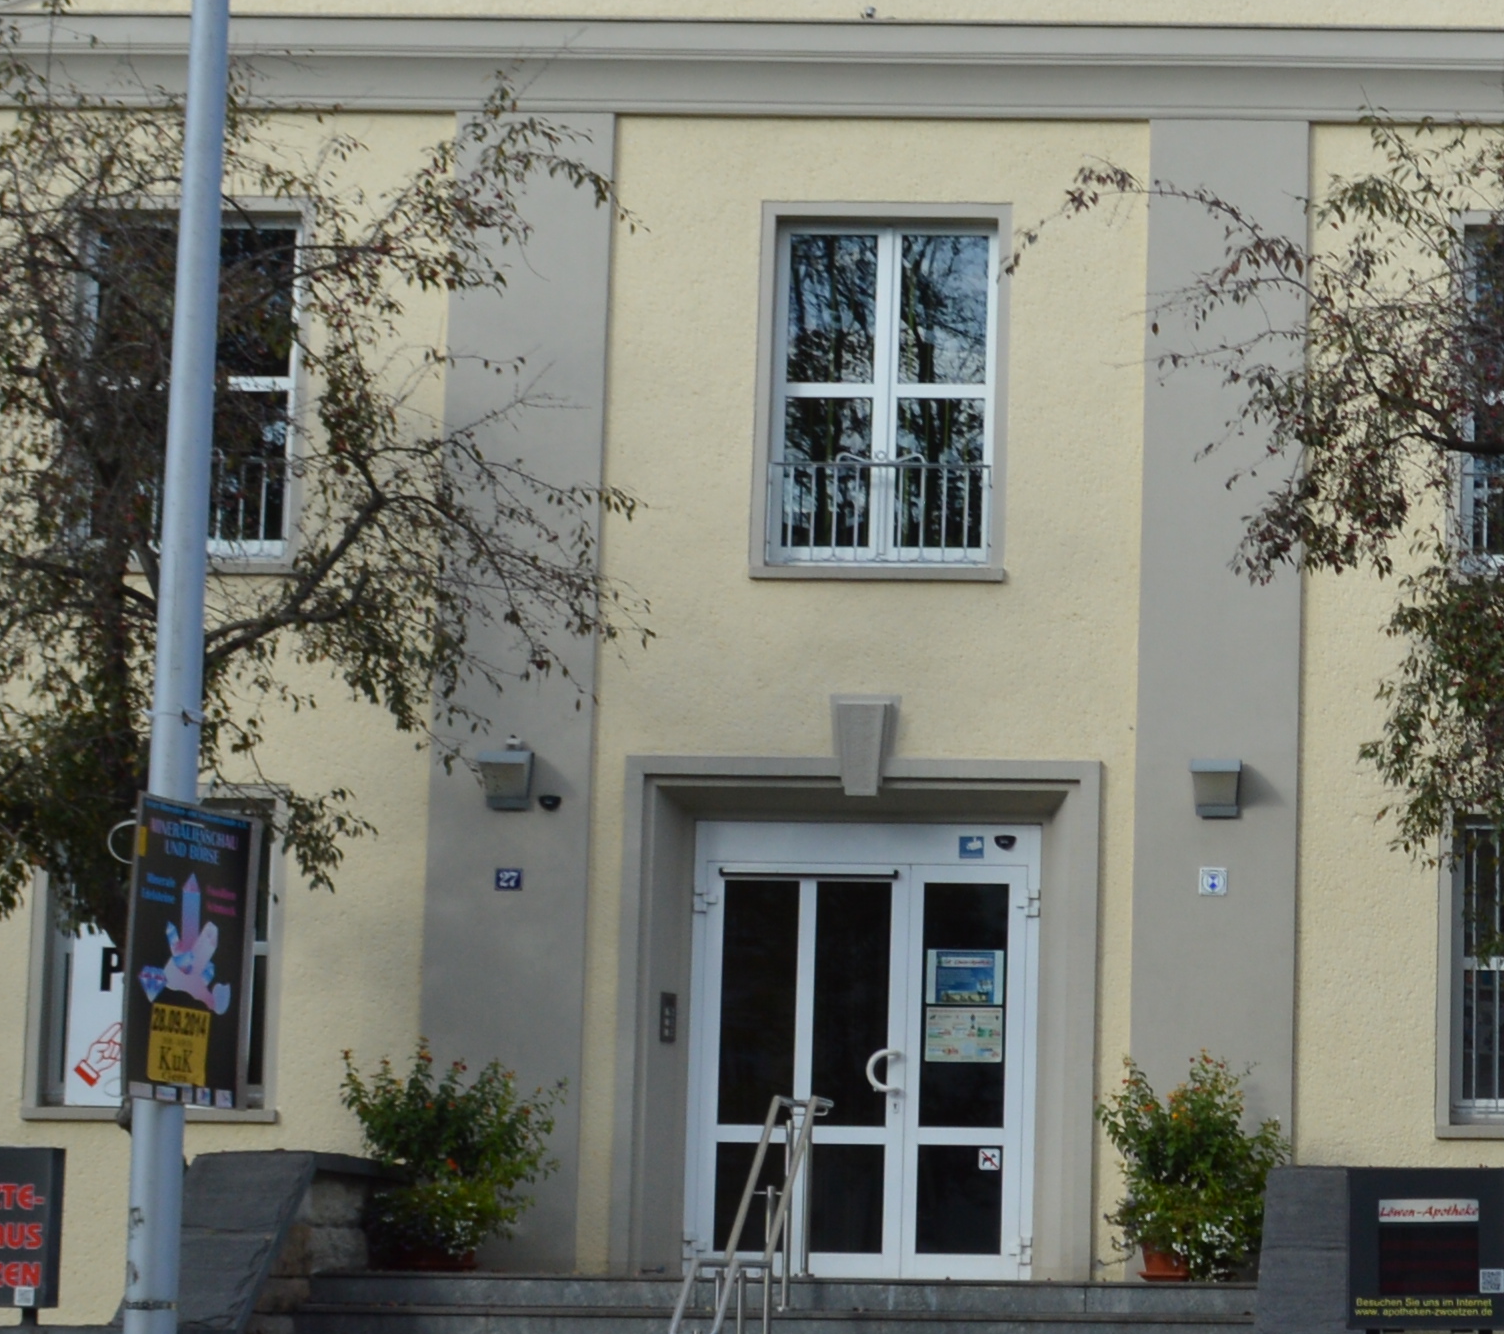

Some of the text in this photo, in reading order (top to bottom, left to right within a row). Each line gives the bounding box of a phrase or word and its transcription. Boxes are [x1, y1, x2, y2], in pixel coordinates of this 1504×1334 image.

[499, 871, 519, 887] 27
[152, 1006, 207, 1037] 28.09.2014
[159, 1045, 193, 1074] KuK
[1356, 1297, 1492, 1307] Besuchen Sie uns im Internet
